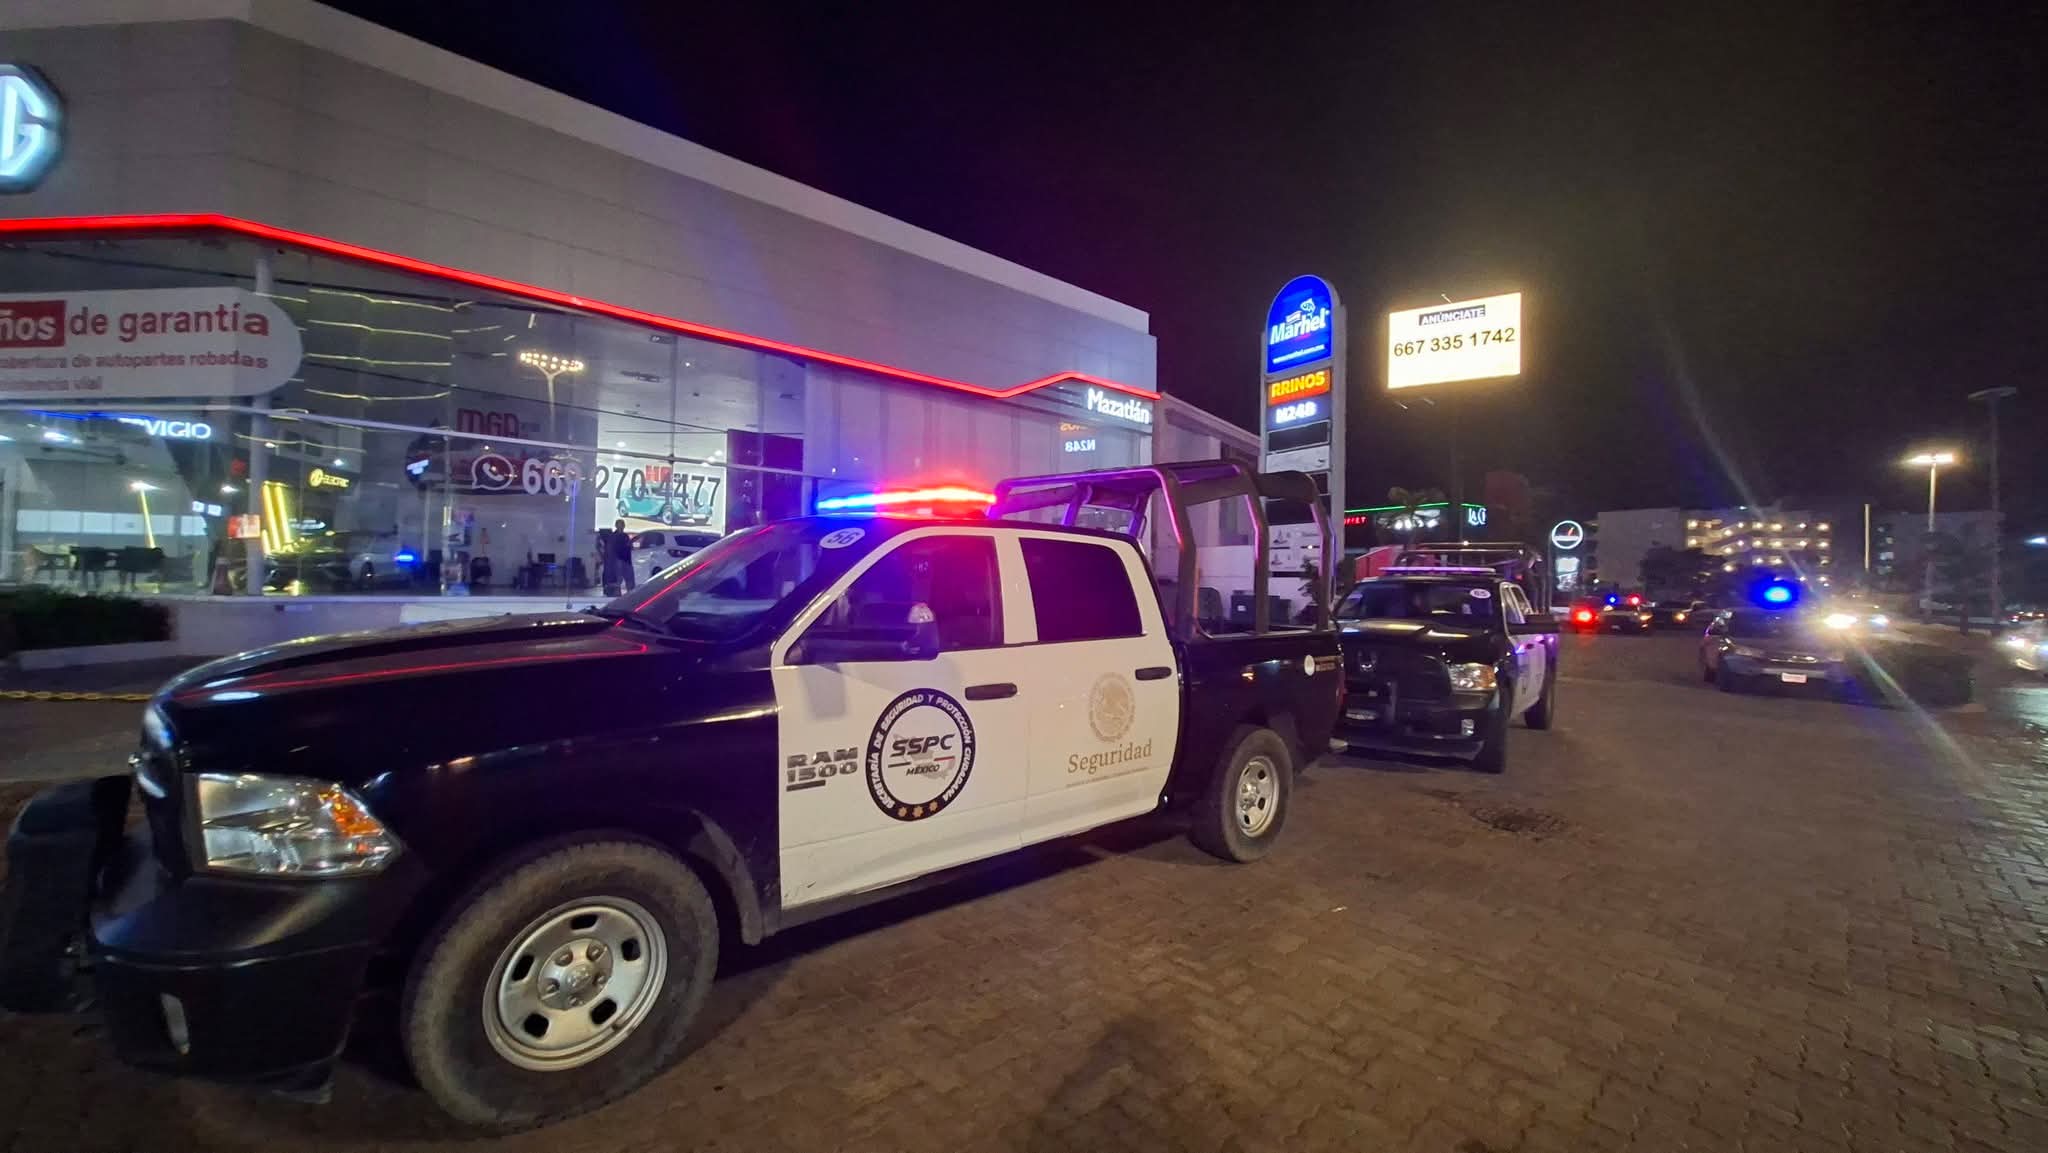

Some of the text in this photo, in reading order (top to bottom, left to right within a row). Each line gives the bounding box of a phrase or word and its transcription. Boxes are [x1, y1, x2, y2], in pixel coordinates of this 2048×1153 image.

[70, 306, 108, 335] de
[119, 303, 270, 342] garantía
[1270, 307, 1327, 345] Marhel
[1393, 327, 1516, 357] 667 335 1742
[1271, 371, 1327, 398] RRINOS
[1087, 387, 1150, 425] Mazatlán
[596, 465, 646, 502] 270
[826, 530, 861, 545] 56
[873, 731, 884, 750] DE
[880, 694, 924, 732] SEGURIDAD
[927, 694, 935, 703] Y
[936, 696, 972, 744] PROTECCIÓN
[787, 747, 858, 768] RAM
[889, 734, 956, 758] SSPC
[1067, 737, 1153, 775] Seguridad
[787, 761, 858, 784] 1500
